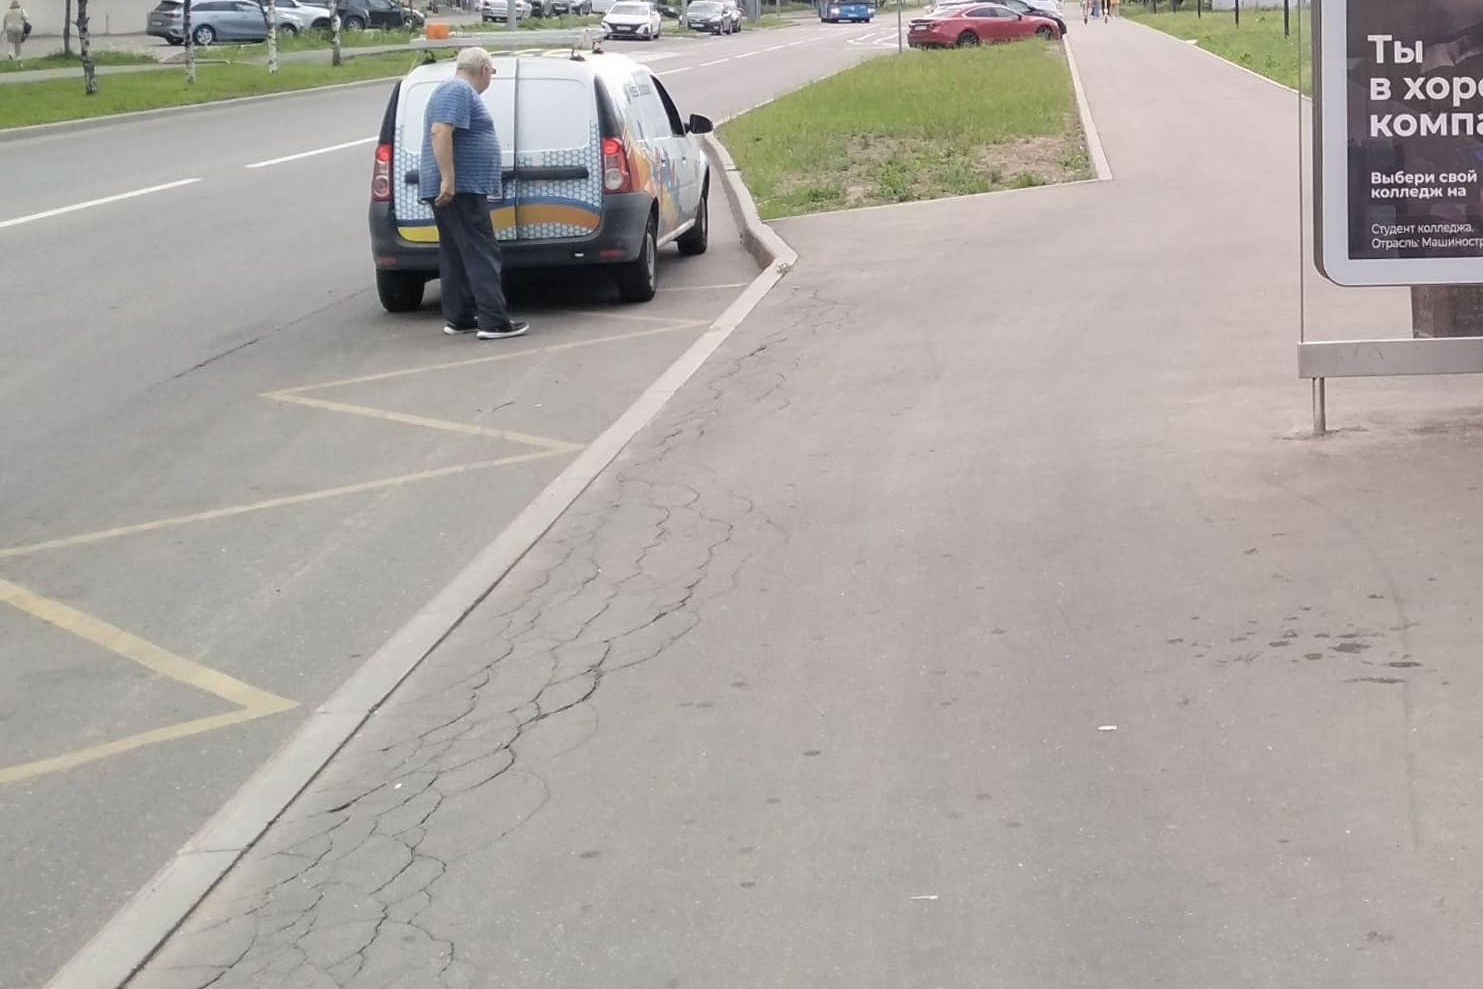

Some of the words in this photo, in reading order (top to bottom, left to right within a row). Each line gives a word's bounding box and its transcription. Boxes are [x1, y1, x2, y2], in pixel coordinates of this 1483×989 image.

[1367, 34, 1423, 63] Ты
[1370, 77, 1391, 101] в
[1371, 171, 1435, 186] Выбери
[1439, 169, 1478, 183] свой
[1371, 186, 1443, 199] колледж
[1447, 186, 1467, 197] на
[1371, 223, 1415, 237] Студент
